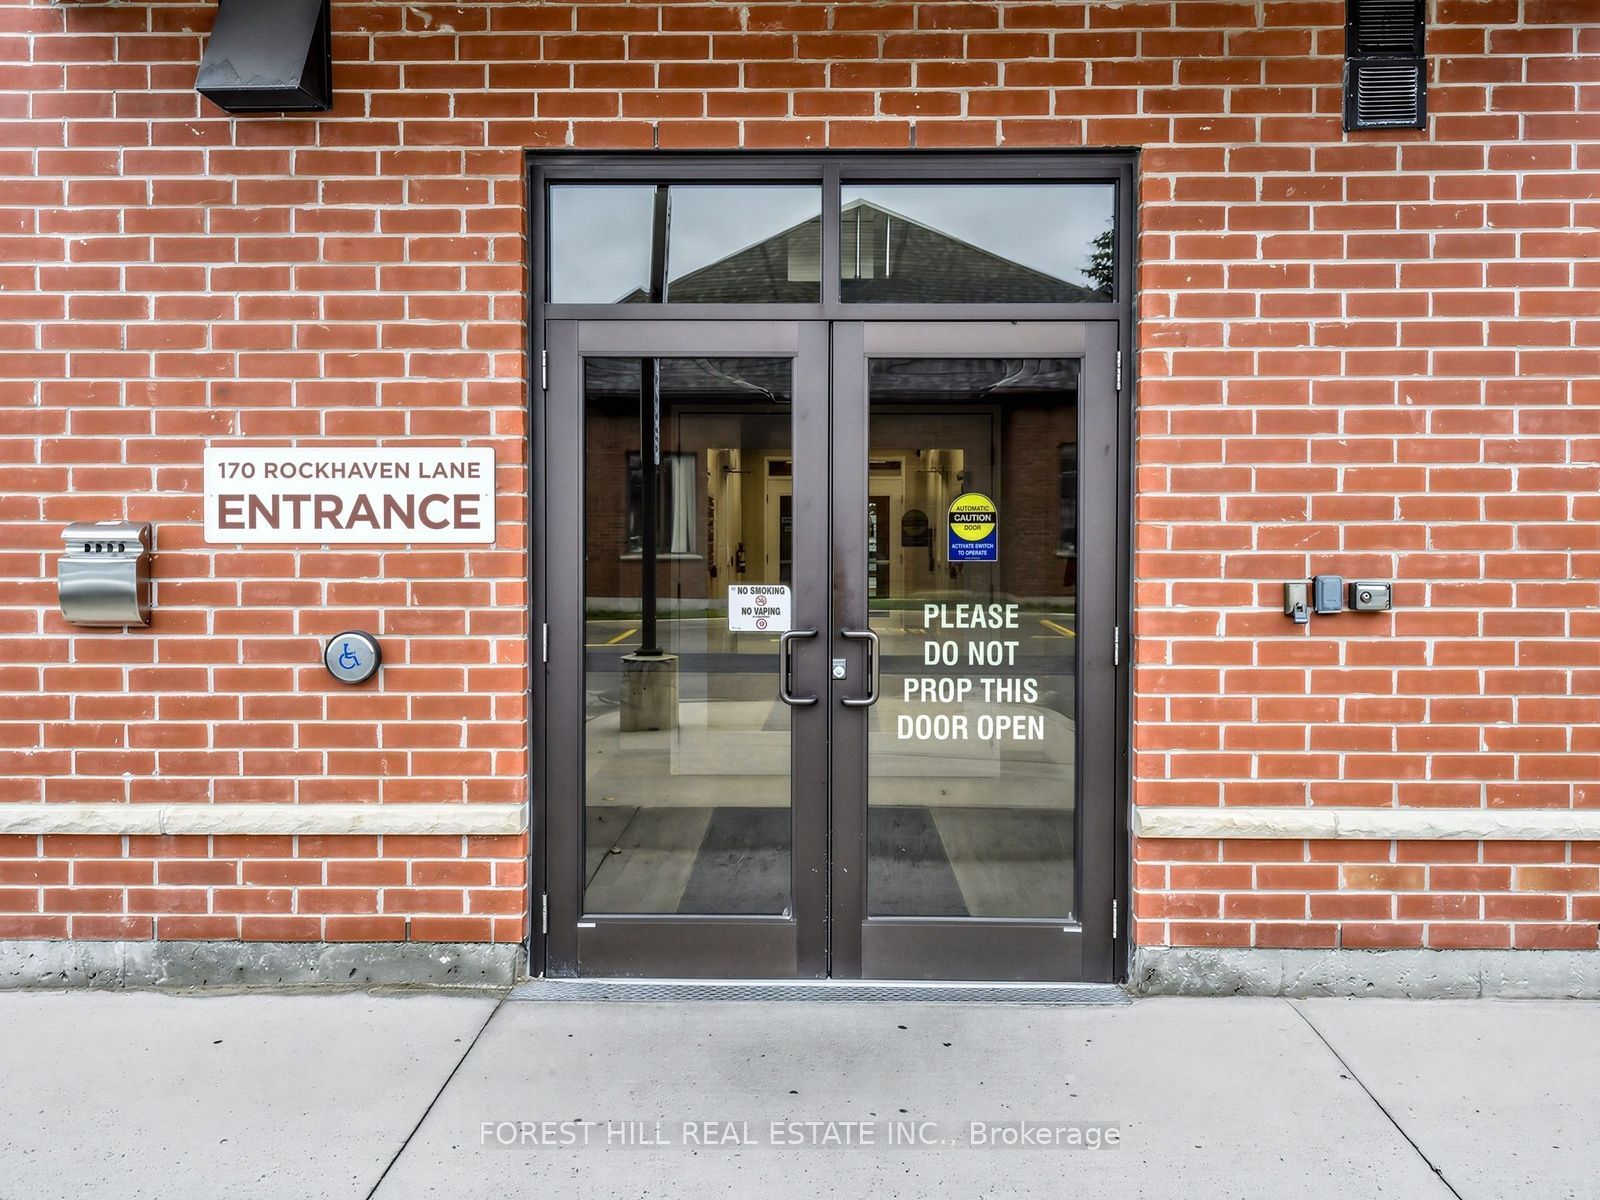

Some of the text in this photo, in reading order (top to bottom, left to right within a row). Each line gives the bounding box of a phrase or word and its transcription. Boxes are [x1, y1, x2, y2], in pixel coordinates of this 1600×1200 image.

[218, 462, 481, 479] 170 ROCKHAVEN LANE
[218, 493, 481, 530] ENTRANCE
[737, 586, 748, 594] NO
[750, 586, 785, 594] SMOKING
[742, 607, 781, 616] NO VAPING
[924, 604, 1019, 629] PLEASE
[924, 641, 1020, 666] DO NOT
[904, 678, 1038, 703] PROP THIS
[897, 715, 1044, 740] DOOR OPEN
